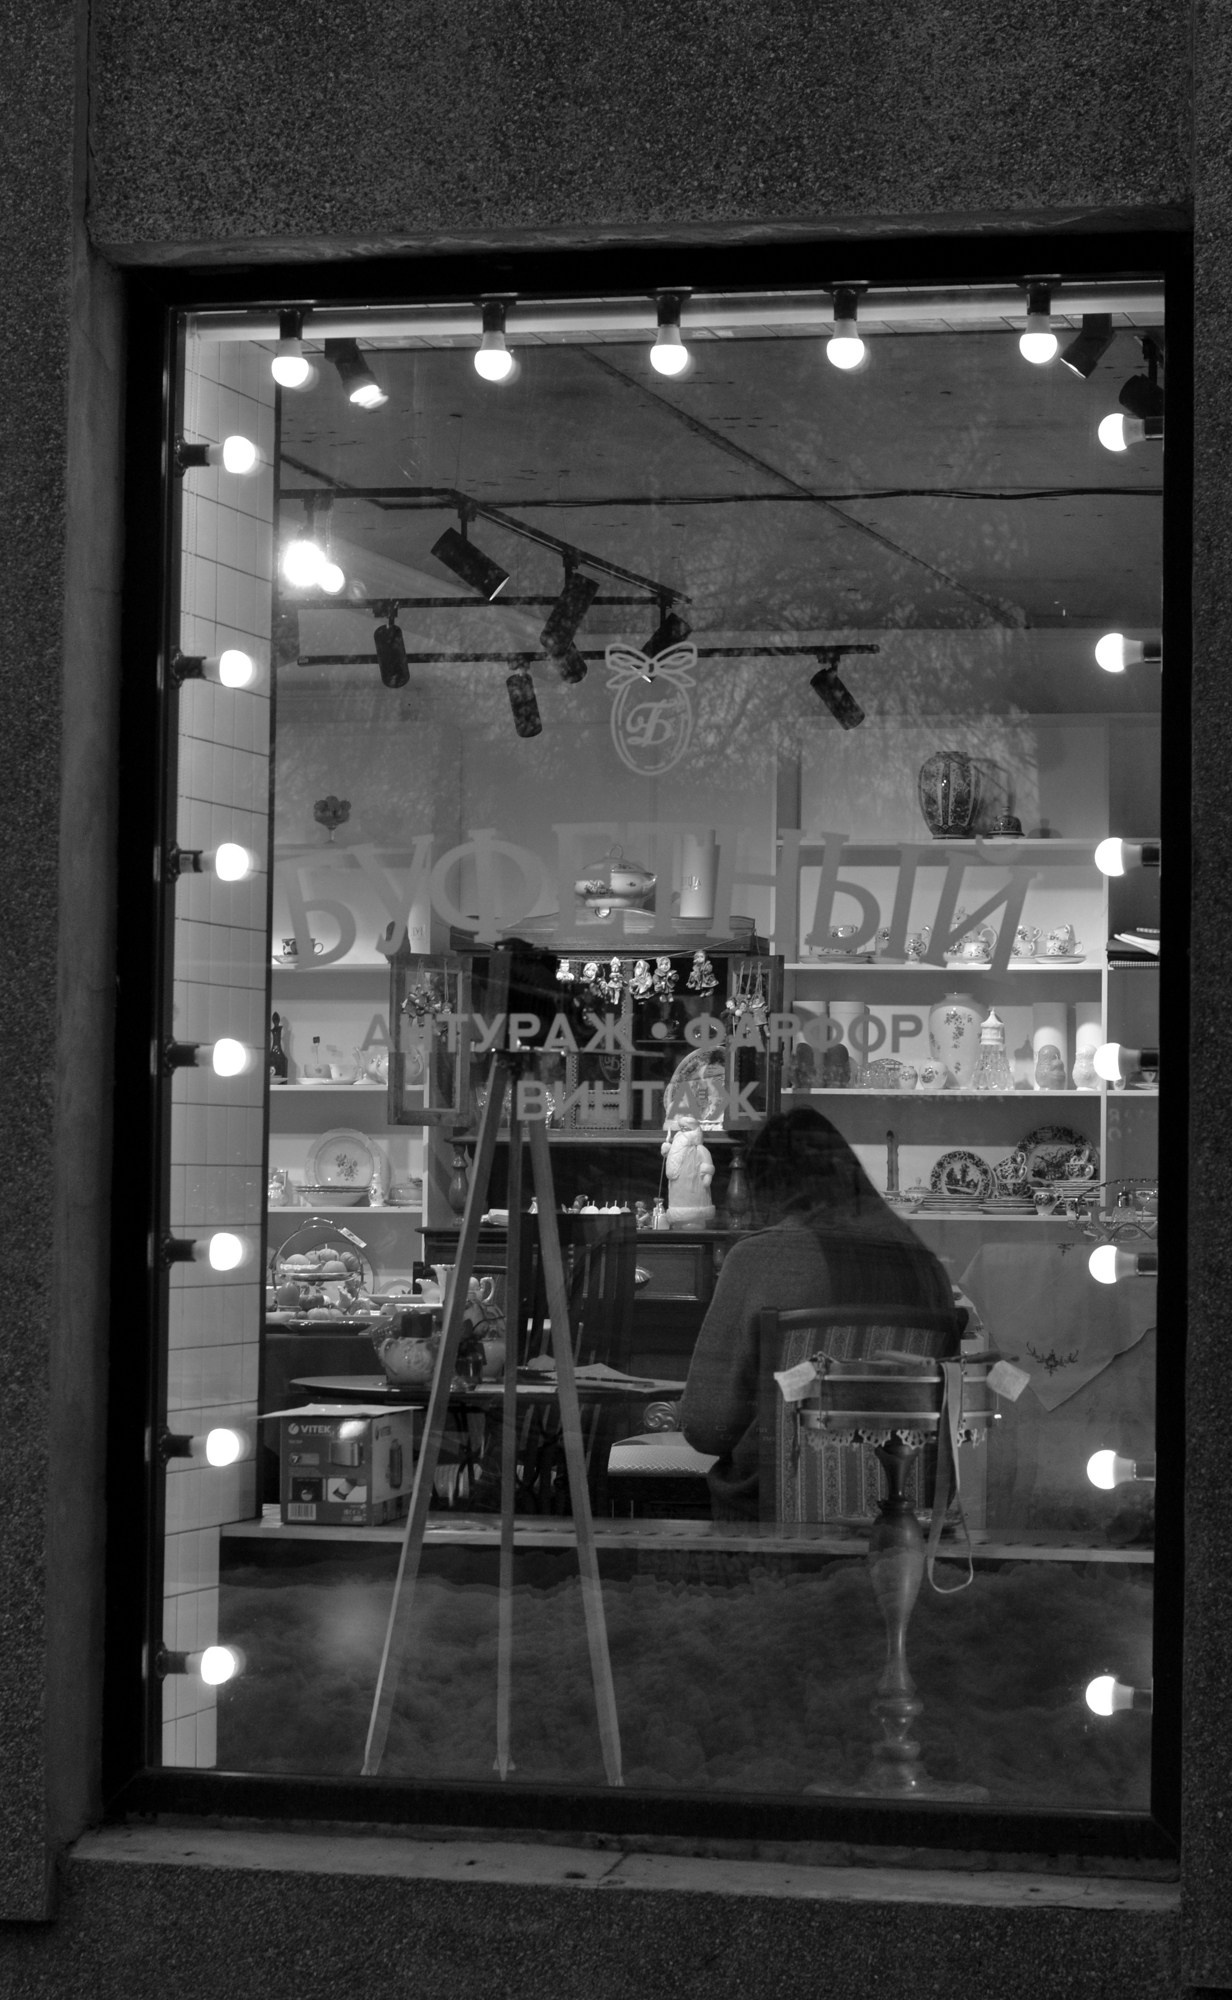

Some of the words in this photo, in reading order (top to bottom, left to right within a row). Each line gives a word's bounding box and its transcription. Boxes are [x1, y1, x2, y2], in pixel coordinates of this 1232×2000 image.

[274, 821, 1043, 981] БУФЕТНЫЙ
[361, 1012, 637, 1053] АНТУРАЖ
[684, 1012, 923, 1053] ФАРФОР
[516, 1080, 763, 1121] ВИНТАЖ
[301, 1424, 331, 1434] VITEK
